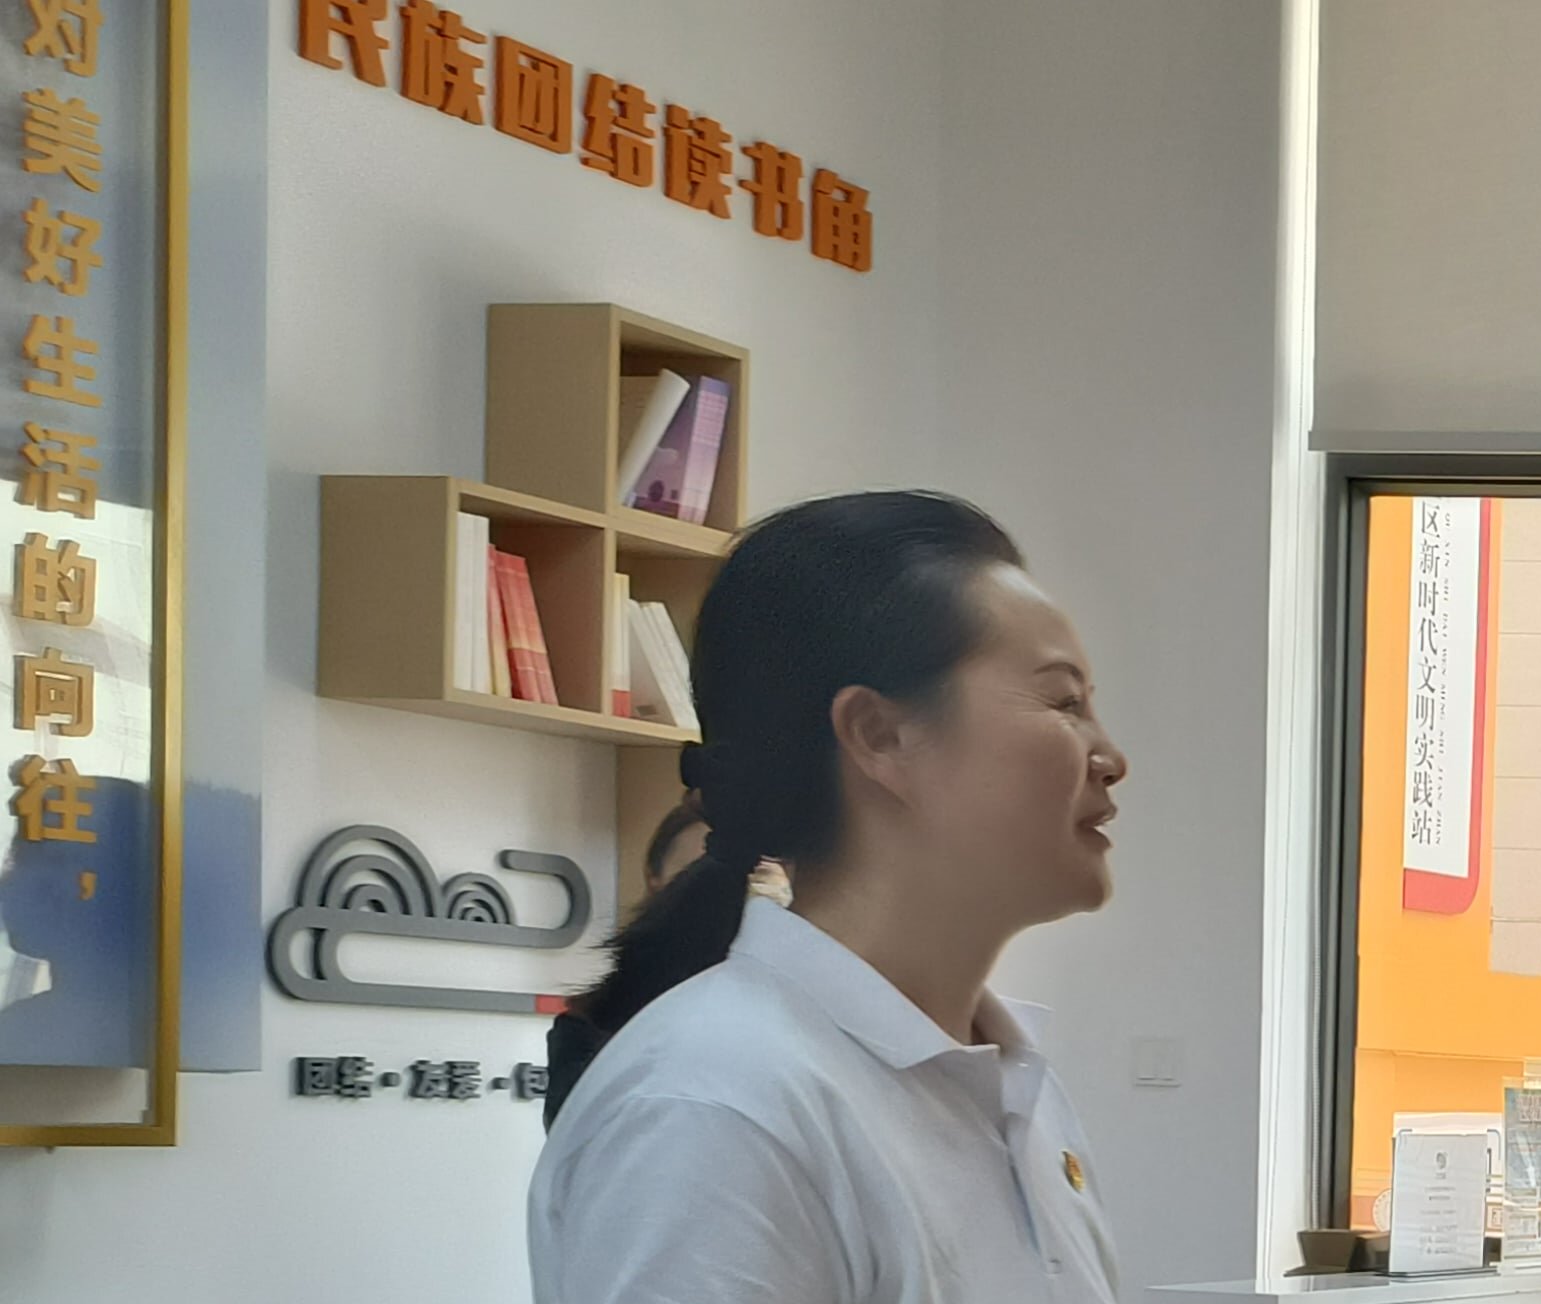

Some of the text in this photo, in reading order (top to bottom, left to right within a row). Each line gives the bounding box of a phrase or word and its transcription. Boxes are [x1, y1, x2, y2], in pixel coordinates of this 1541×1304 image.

[1411, 500, 1440, 845] 区新时代文明实践站
